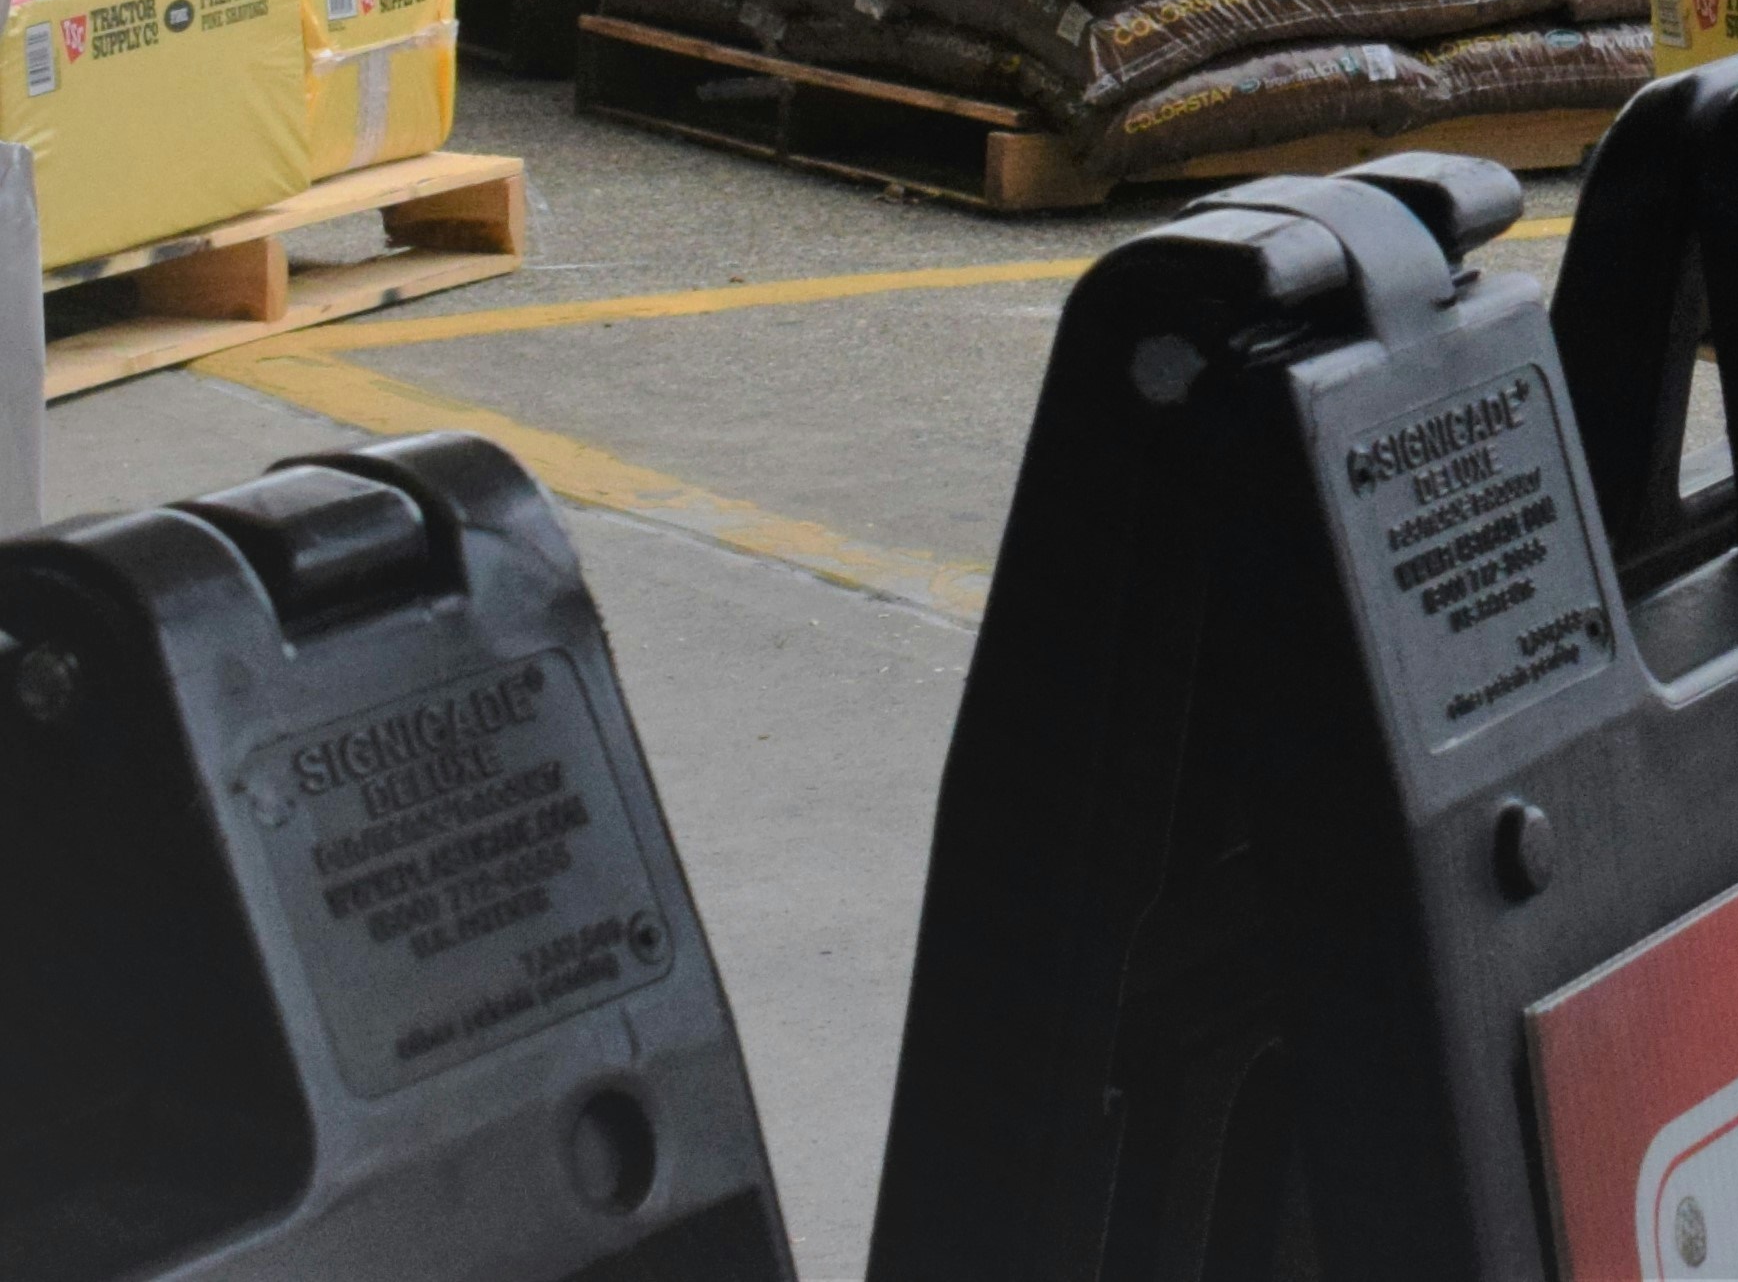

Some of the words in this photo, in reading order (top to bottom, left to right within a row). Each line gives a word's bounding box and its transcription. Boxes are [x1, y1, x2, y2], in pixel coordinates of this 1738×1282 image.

[93, 29, 139, 60] SUPPLY
[1413, 449, 1502, 505] DELUXE
[362, 749, 502, 820] DELUXE
